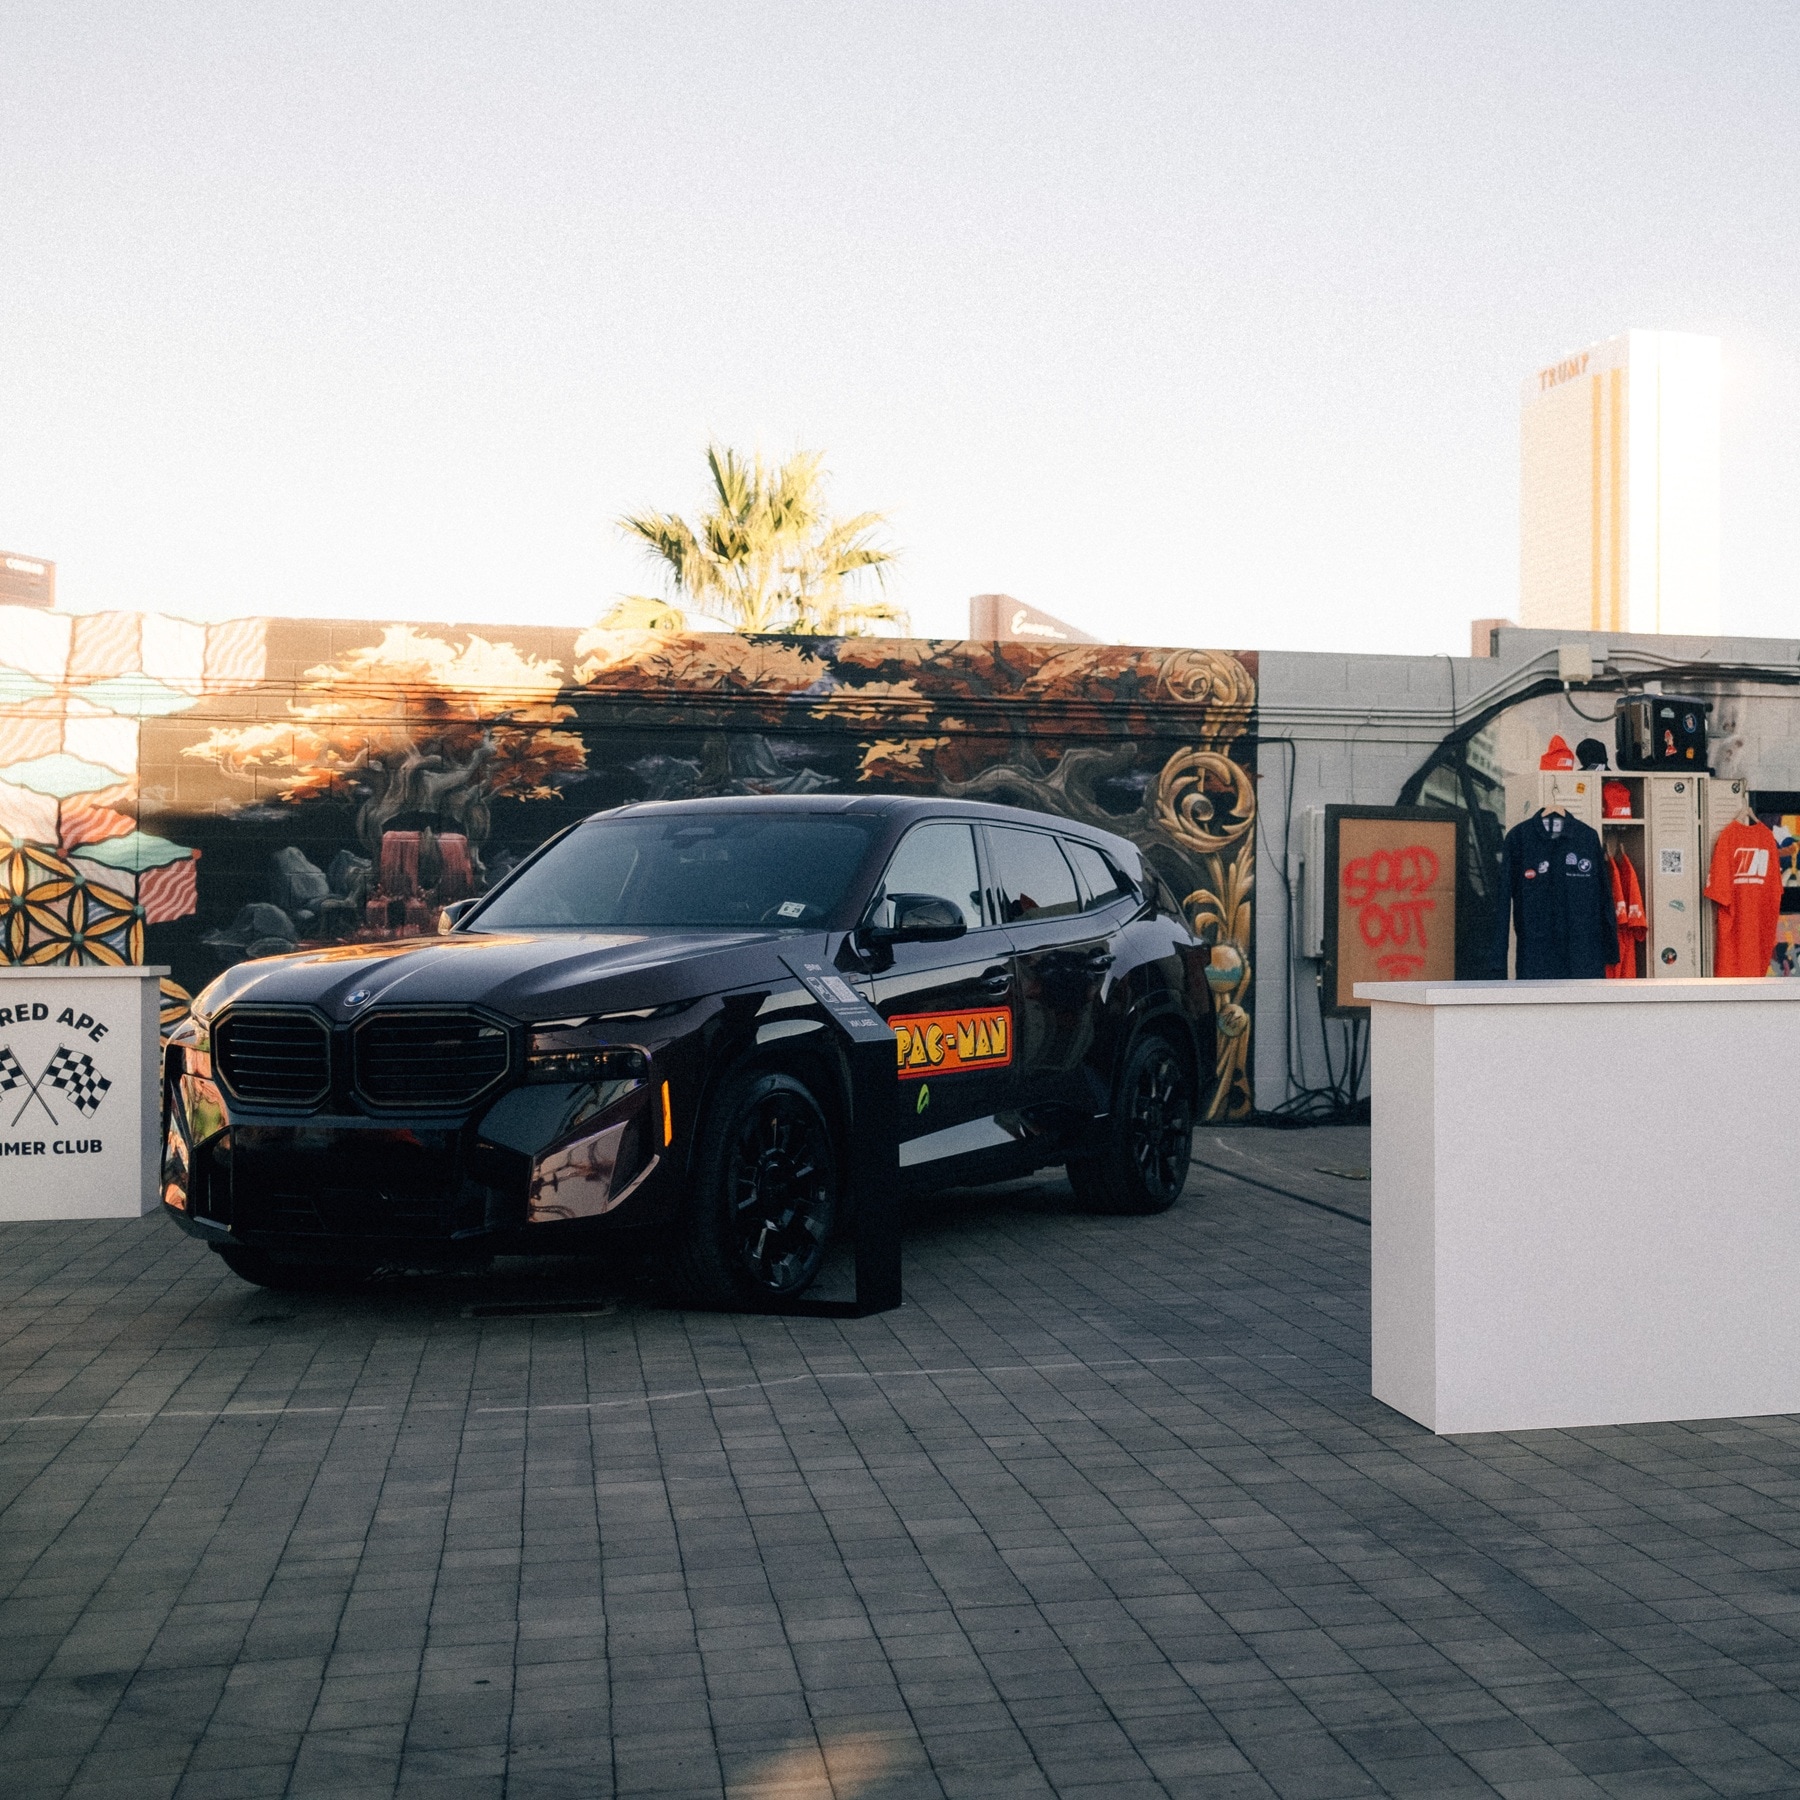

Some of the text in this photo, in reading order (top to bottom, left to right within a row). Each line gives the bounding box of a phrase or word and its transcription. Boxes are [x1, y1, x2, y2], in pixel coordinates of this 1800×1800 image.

[1359, 899, 1436, 949] OUT
[56, 1007, 109, 1043] APE
[895, 1017, 1006, 1067] PAC-MAN
[53, 1139, 103, 1154] CLUB
